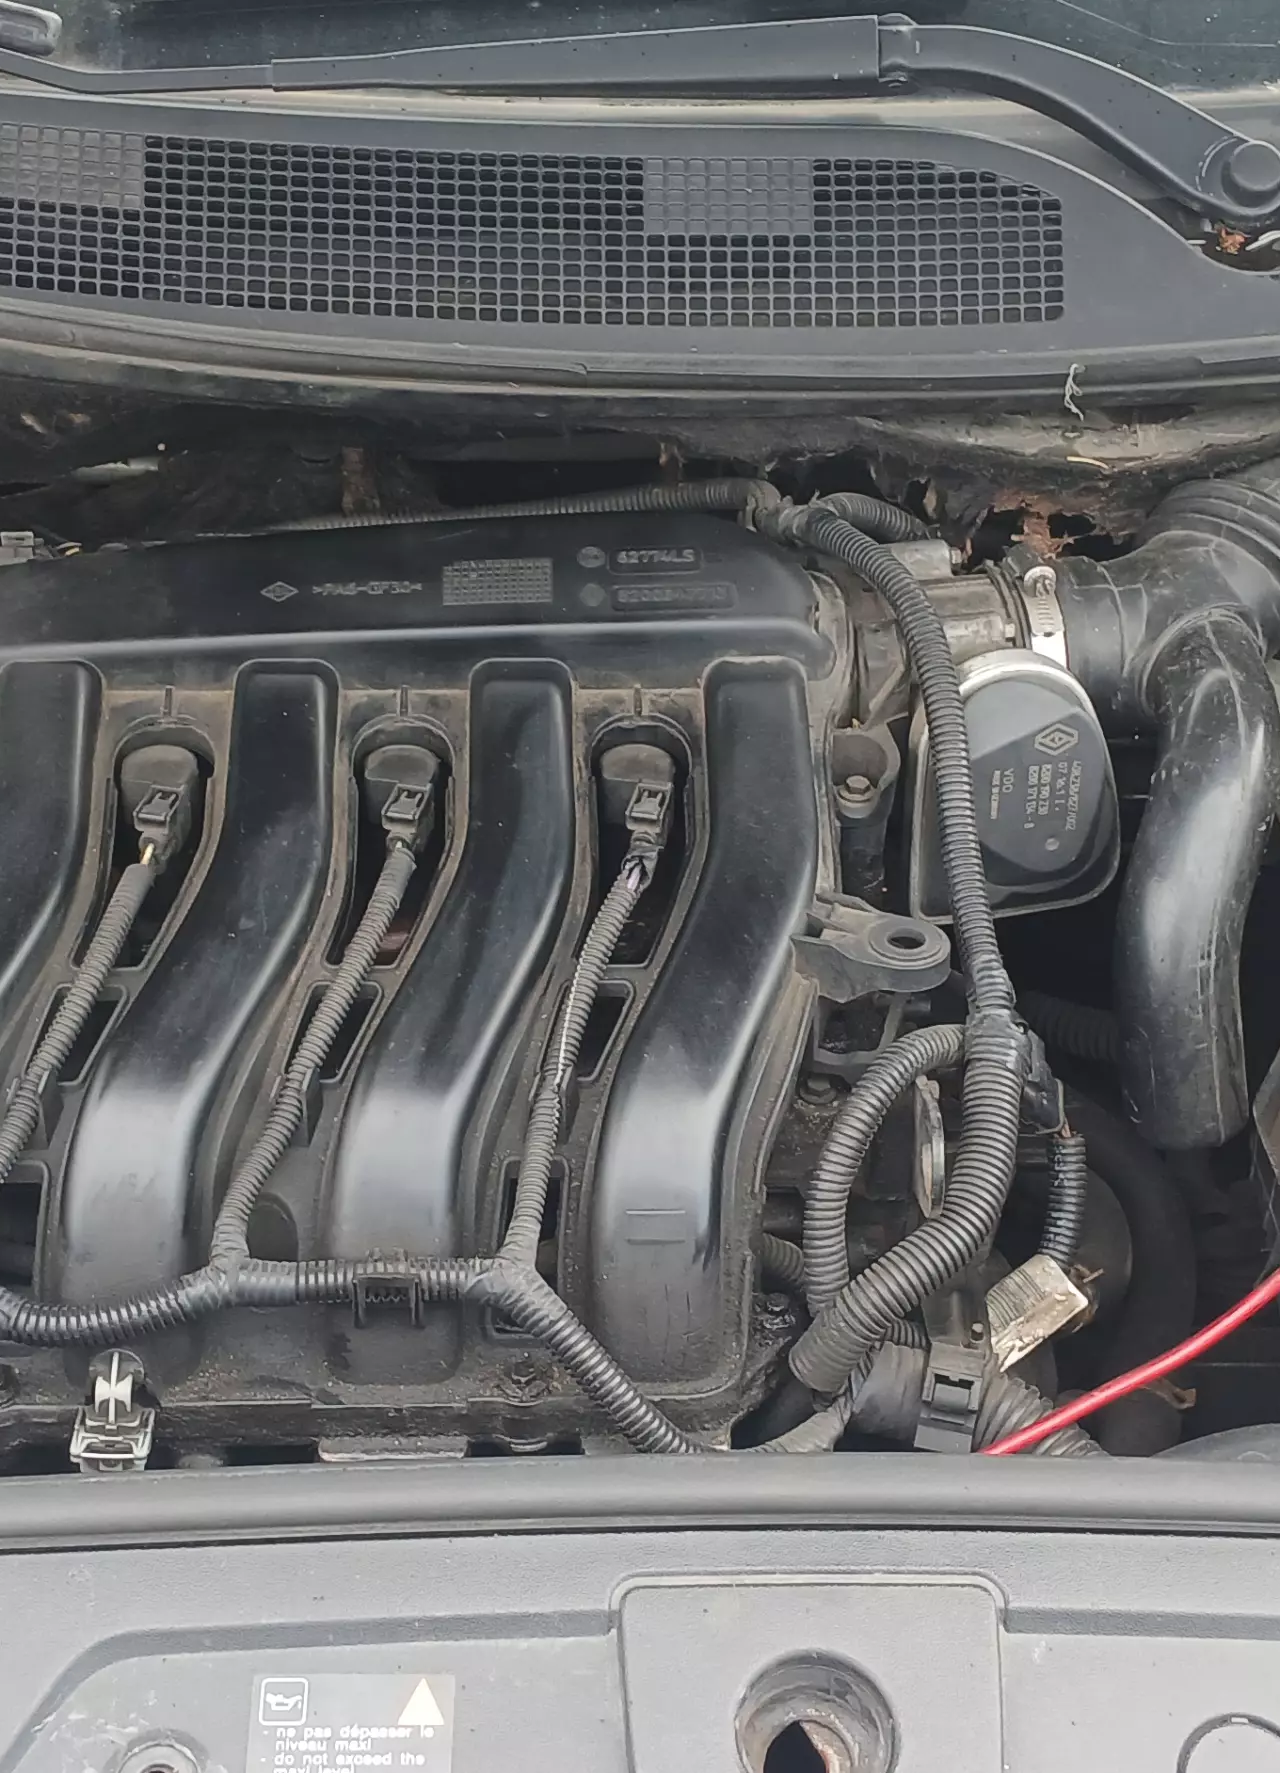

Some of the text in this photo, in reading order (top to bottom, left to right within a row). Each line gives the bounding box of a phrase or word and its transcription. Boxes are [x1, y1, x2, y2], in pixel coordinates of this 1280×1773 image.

[276, 1727, 296, 1738] ne
[304, 1727, 332, 1740] pas
[275, 1738, 372, 1750] niveau maxi
[274, 1752, 294, 1765] do
[302, 1753, 328, 1765] not
[335, 1752, 393, 1765] exceed
[400, 1752, 426, 1765] the
